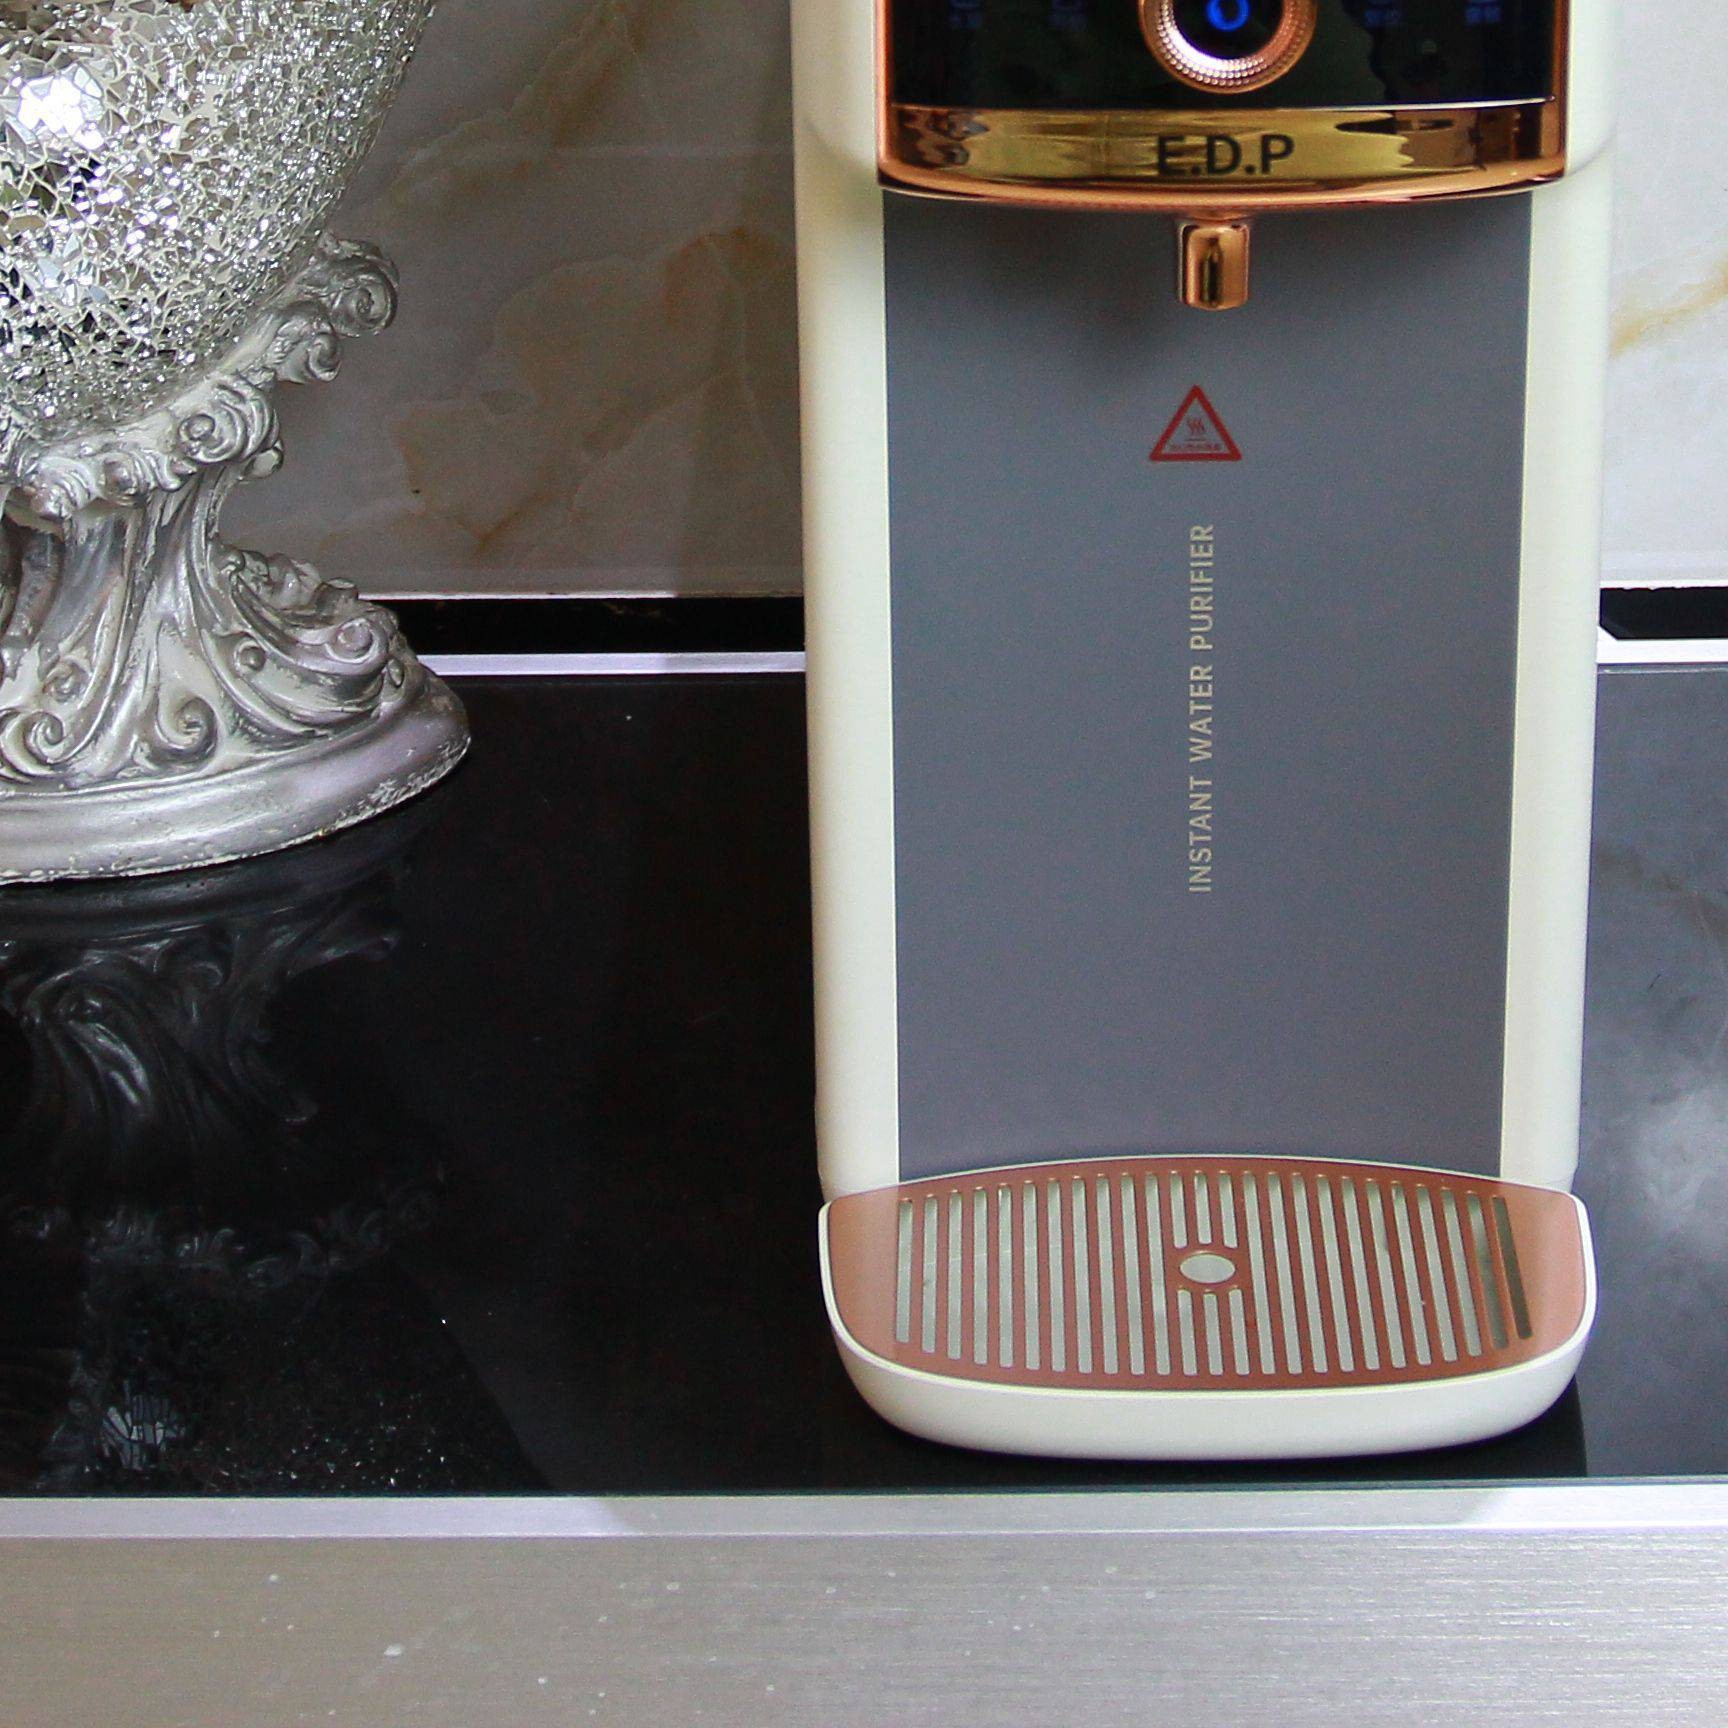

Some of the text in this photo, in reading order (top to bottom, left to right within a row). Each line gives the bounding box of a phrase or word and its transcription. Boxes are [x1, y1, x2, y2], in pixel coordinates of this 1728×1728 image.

[1157, 133, 1295, 176] E.D.P
[1189, 523, 1214, 893] INSTANT WATER PURIFIER
